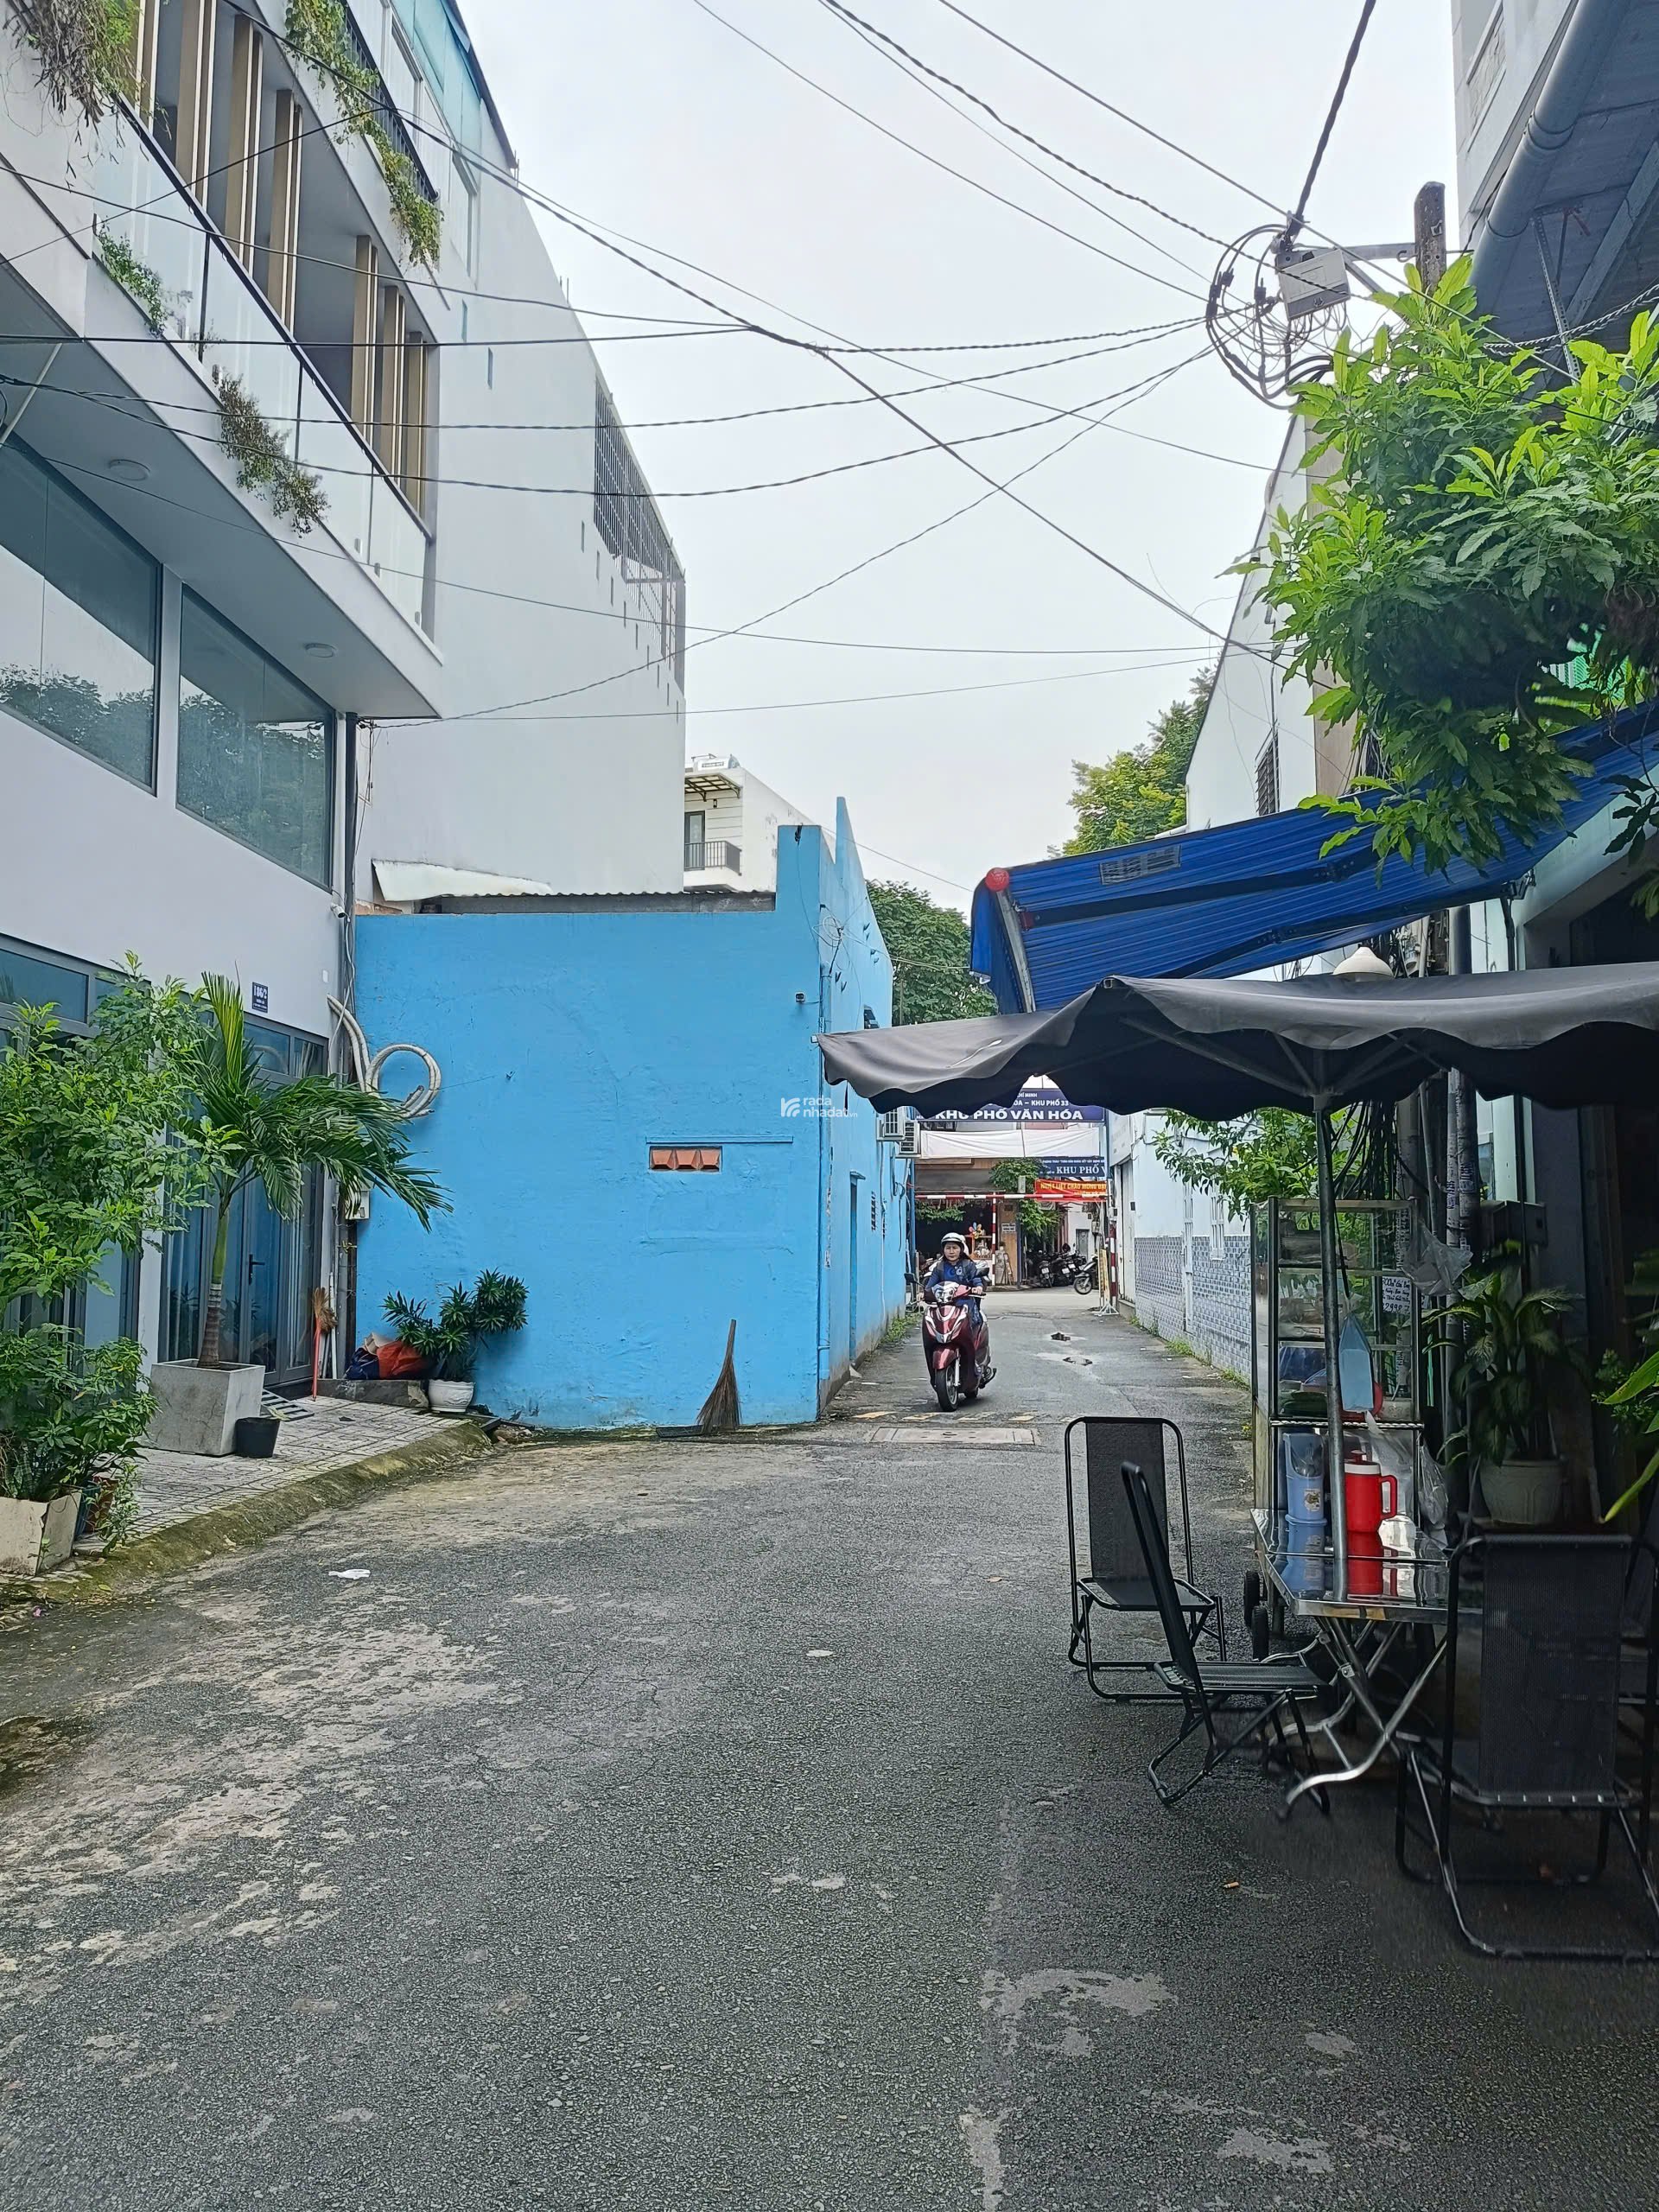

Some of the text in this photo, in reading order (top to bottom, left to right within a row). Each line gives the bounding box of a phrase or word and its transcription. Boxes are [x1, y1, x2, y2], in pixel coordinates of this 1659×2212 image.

[973, 1108, 1008, 1120] PHỐ
[1010, 1109, 1044, 1120] VĂN
[1048, 1109, 1084, 1120] HÓA
[1079, 1164, 1099, 1173] PHỐ
